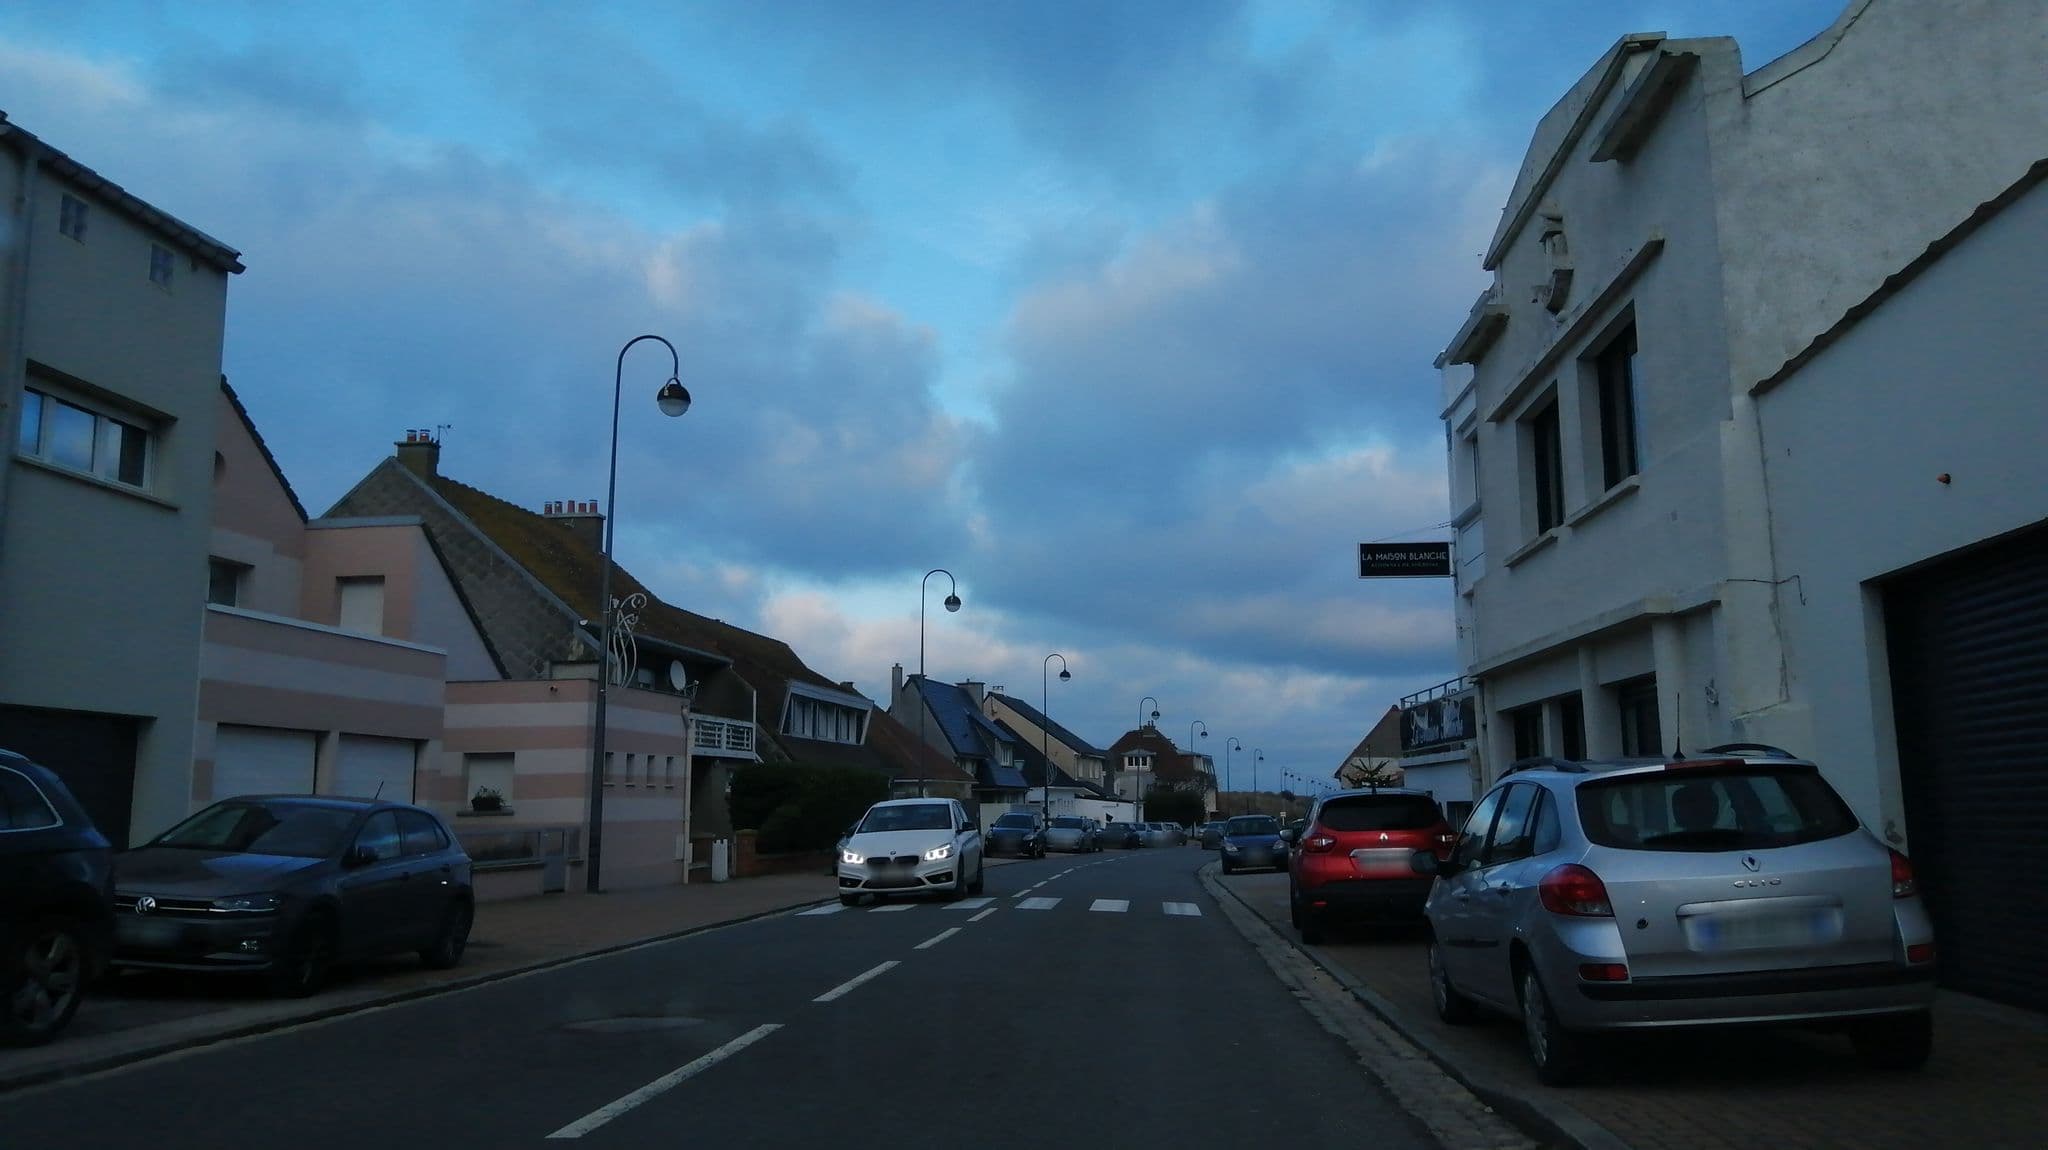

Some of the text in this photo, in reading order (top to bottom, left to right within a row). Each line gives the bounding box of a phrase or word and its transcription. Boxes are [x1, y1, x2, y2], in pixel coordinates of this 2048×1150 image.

[1362, 551, 1448, 561] LA MAISON BLANCHE
[1733, 877, 1782, 888] CLIO
